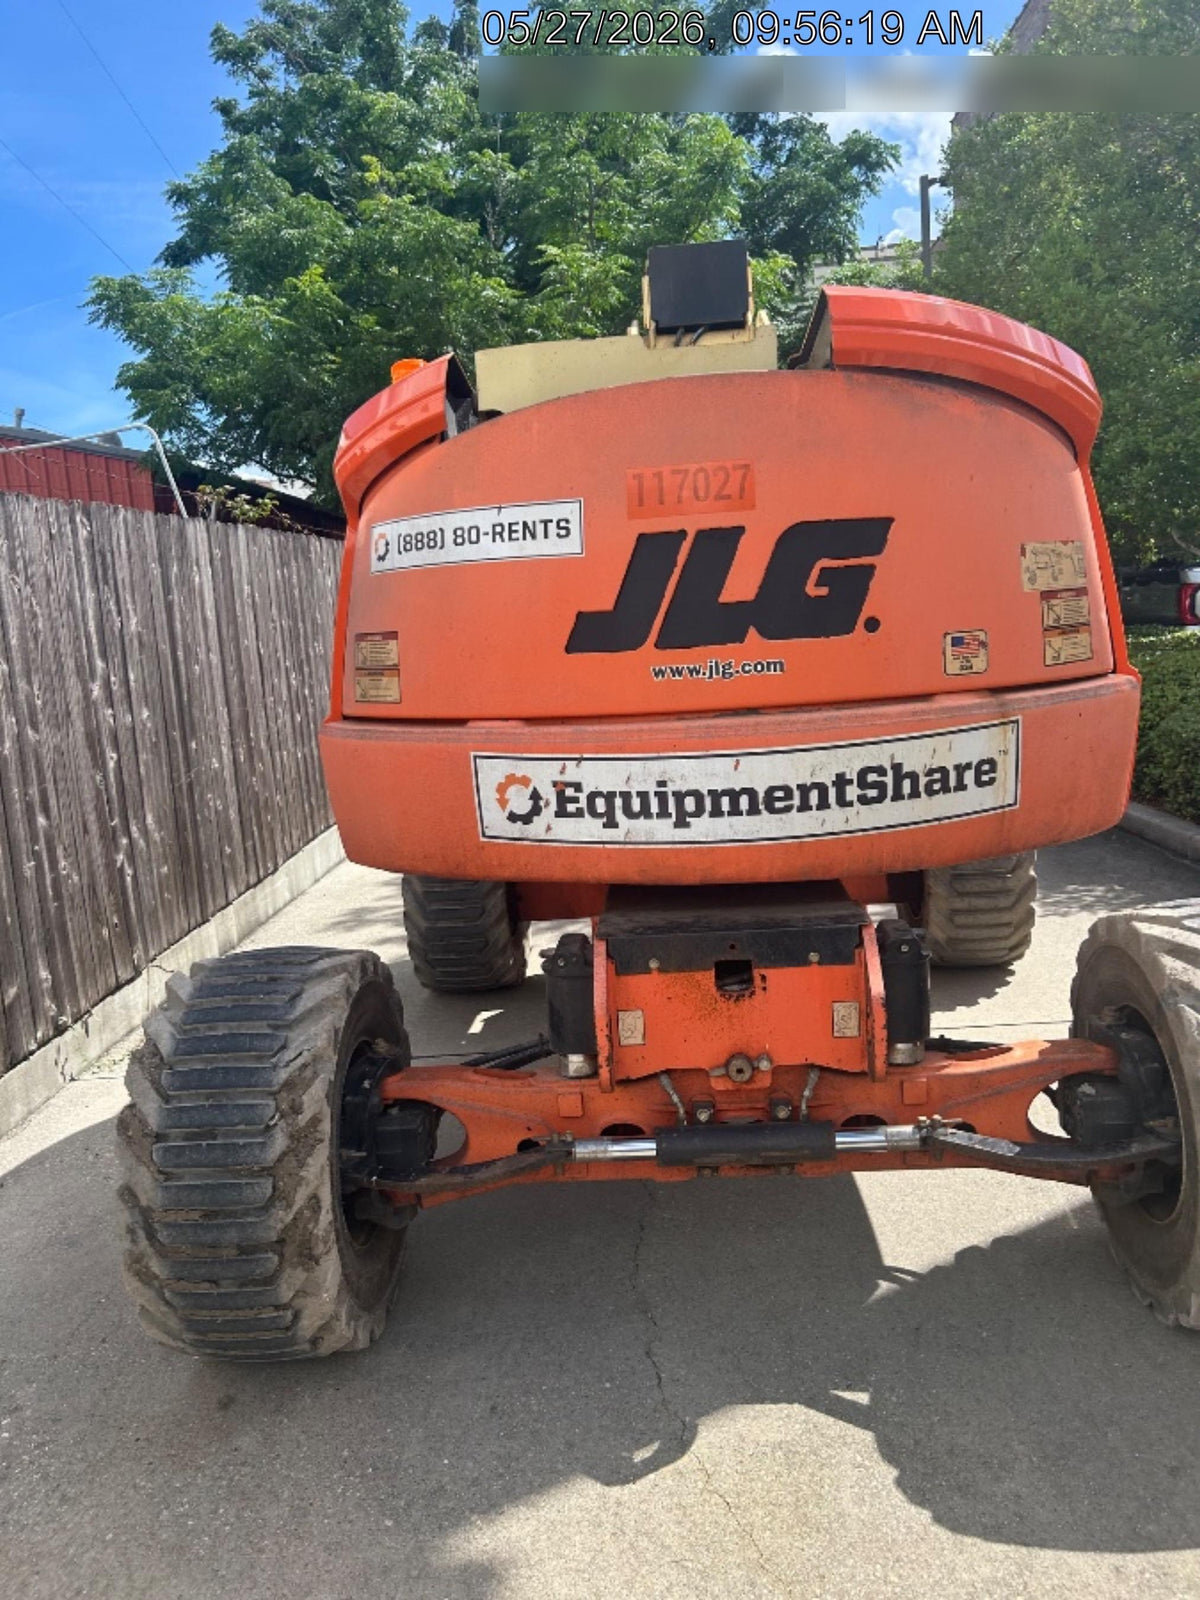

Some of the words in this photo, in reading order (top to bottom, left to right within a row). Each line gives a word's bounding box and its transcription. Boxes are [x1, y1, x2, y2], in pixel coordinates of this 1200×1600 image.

[632, 463, 751, 507] 117027
[397, 527, 445, 555] (888)
[453, 518, 571, 547] 80-RENTS
[651, 658, 785, 681] www.jlg.com
[552, 756, 997, 829] EquipmentShare
